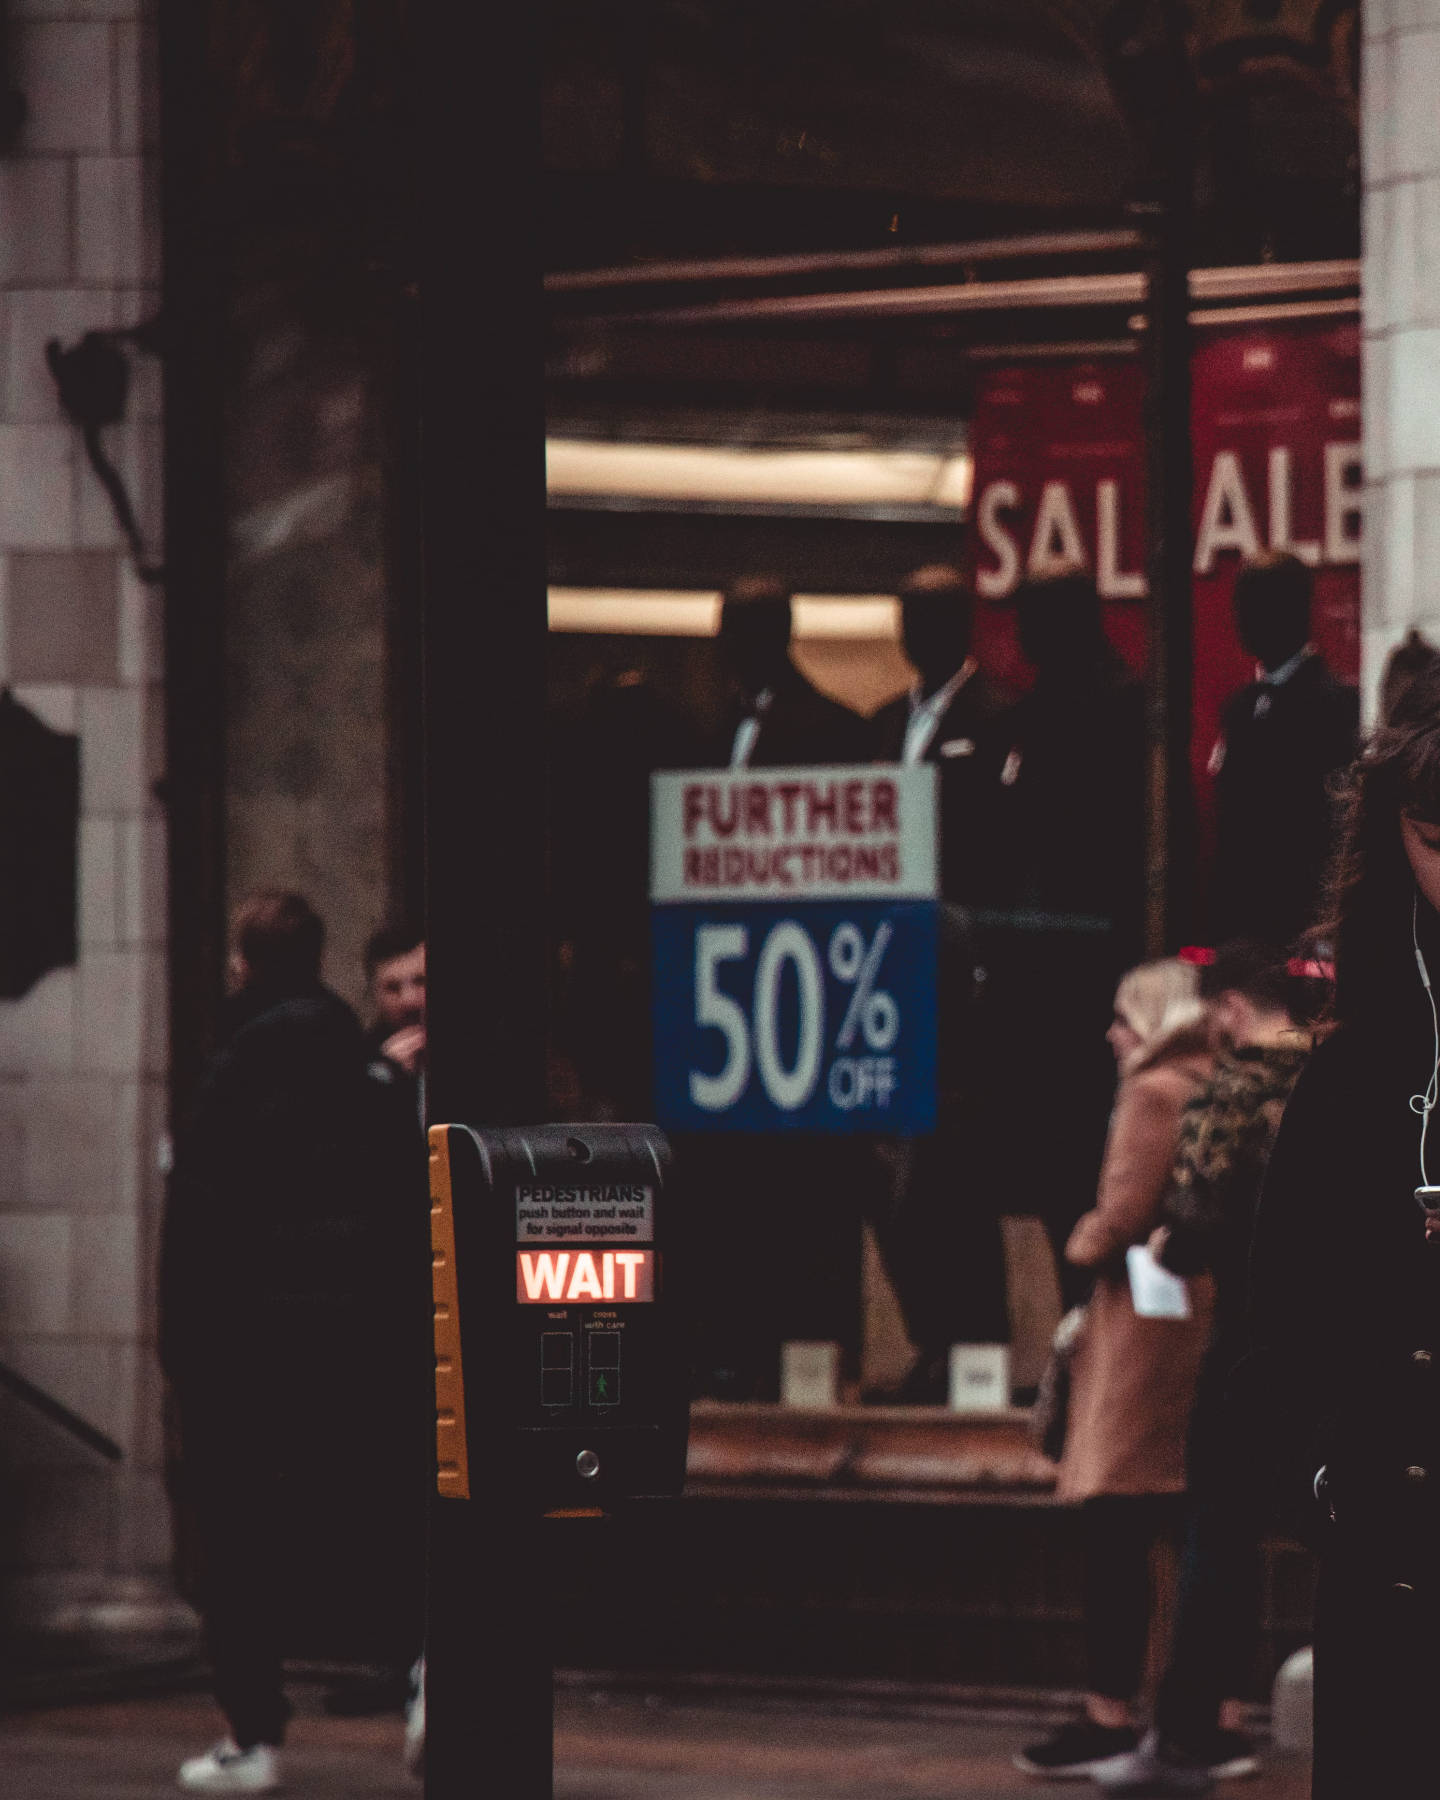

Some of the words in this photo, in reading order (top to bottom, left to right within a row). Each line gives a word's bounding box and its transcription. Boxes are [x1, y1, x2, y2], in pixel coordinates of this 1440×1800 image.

[1192, 442, 1362, 573] ALE
[976, 480, 1150, 598] SAL
[682, 776, 899, 838] FURTHER
[683, 845, 899, 888] REDUCTIONS
[689, 917, 900, 1112] 50%
[828, 1055, 897, 1111] OFF
[519, 1184, 645, 1202] PEDESTRIANS
[519, 1206, 548, 1221] push
[552, 1206, 590, 1218] button
[593, 1206, 616, 1218] and
[618, 1206, 644, 1218] wait
[526, 1222, 544, 1235] for
[546, 1222, 582, 1237] signal
[585, 1222, 637, 1237] opposite
[519, 1253, 645, 1300] WAIT
